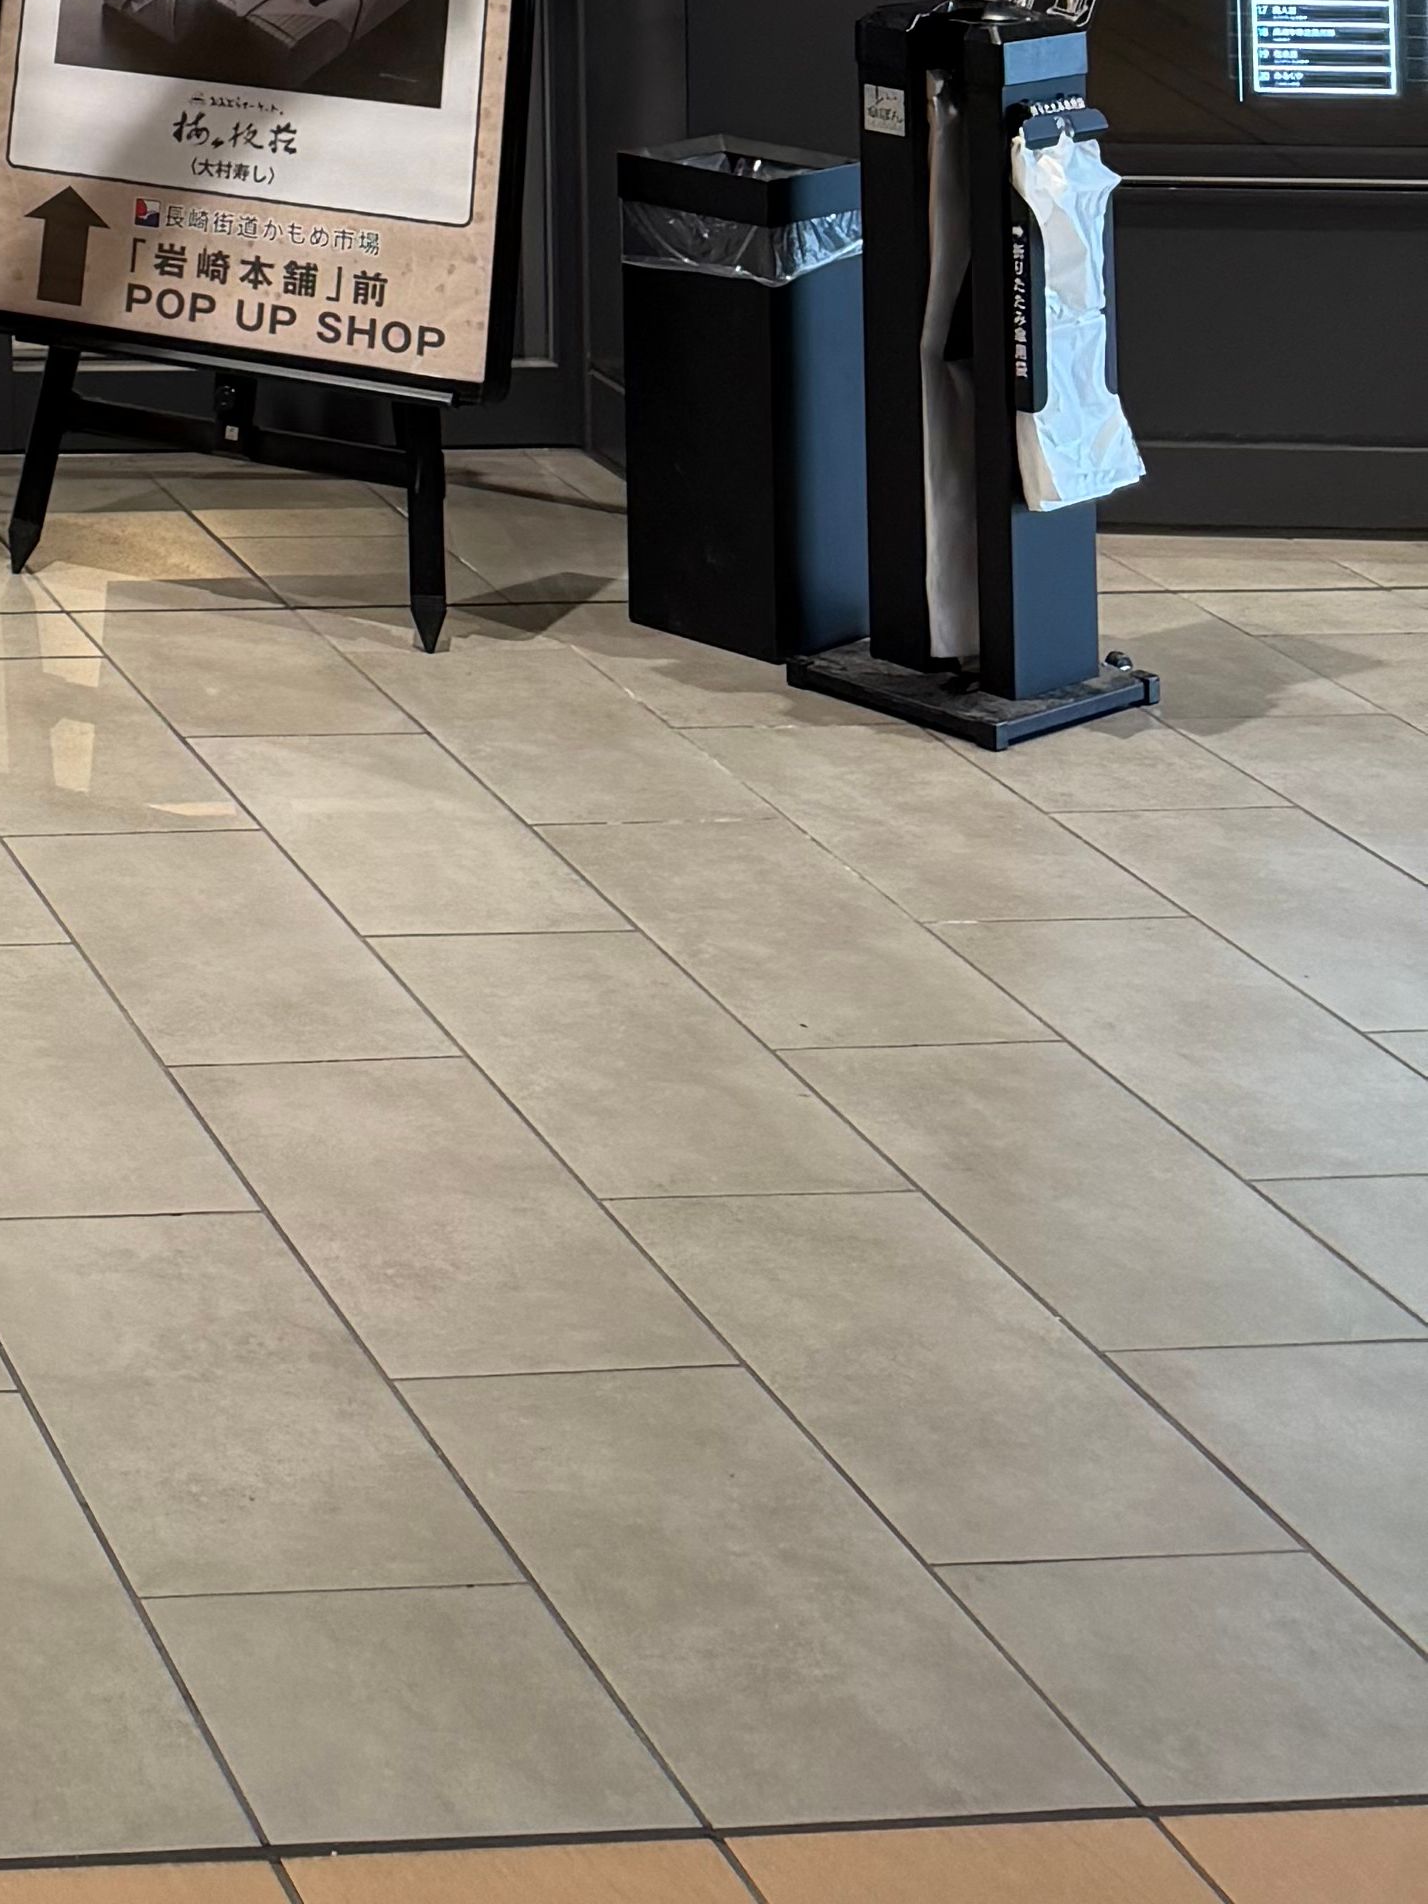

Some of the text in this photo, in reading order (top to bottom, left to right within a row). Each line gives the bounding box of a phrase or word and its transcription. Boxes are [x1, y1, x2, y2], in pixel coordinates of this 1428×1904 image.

[164, 203, 381, 256] 長崎街道かもめ市場
[130, 236, 389, 307] 「岩崎本舗」前
[124, 282, 447, 357] POP UP SHOP
